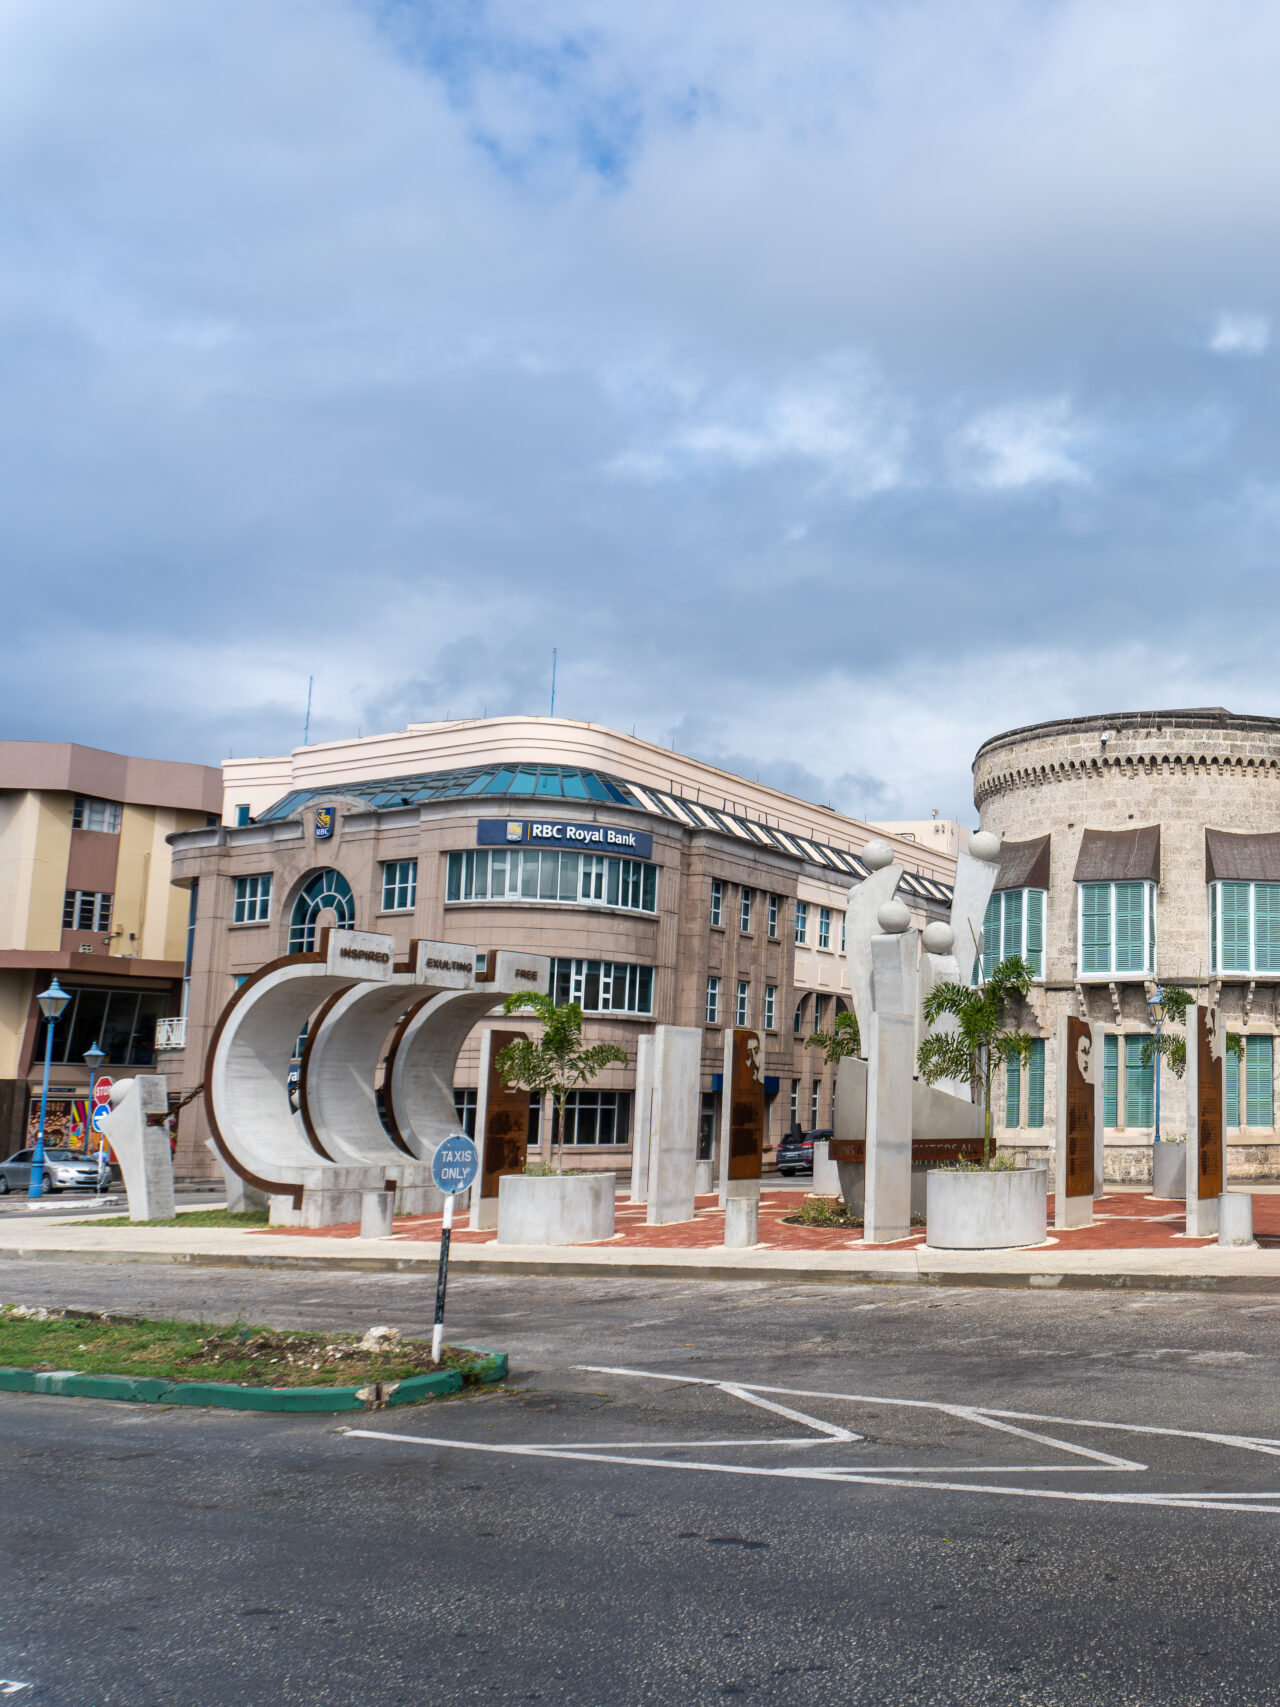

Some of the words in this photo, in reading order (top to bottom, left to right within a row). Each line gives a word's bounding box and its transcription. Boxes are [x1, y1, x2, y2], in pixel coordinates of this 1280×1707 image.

[316, 828, 330, 836] RBC
[532, 824, 562, 839] RBC
[566, 826, 604, 844] Royal
[607, 830, 636, 847] Bank
[340, 947, 390, 963] INSPIRED
[427, 957, 473, 973] EXULTING
[515, 968, 538, 982] FREE
[441, 1150, 472, 1162] TAXIS
[441, 1167, 469, 1179] ONLY
